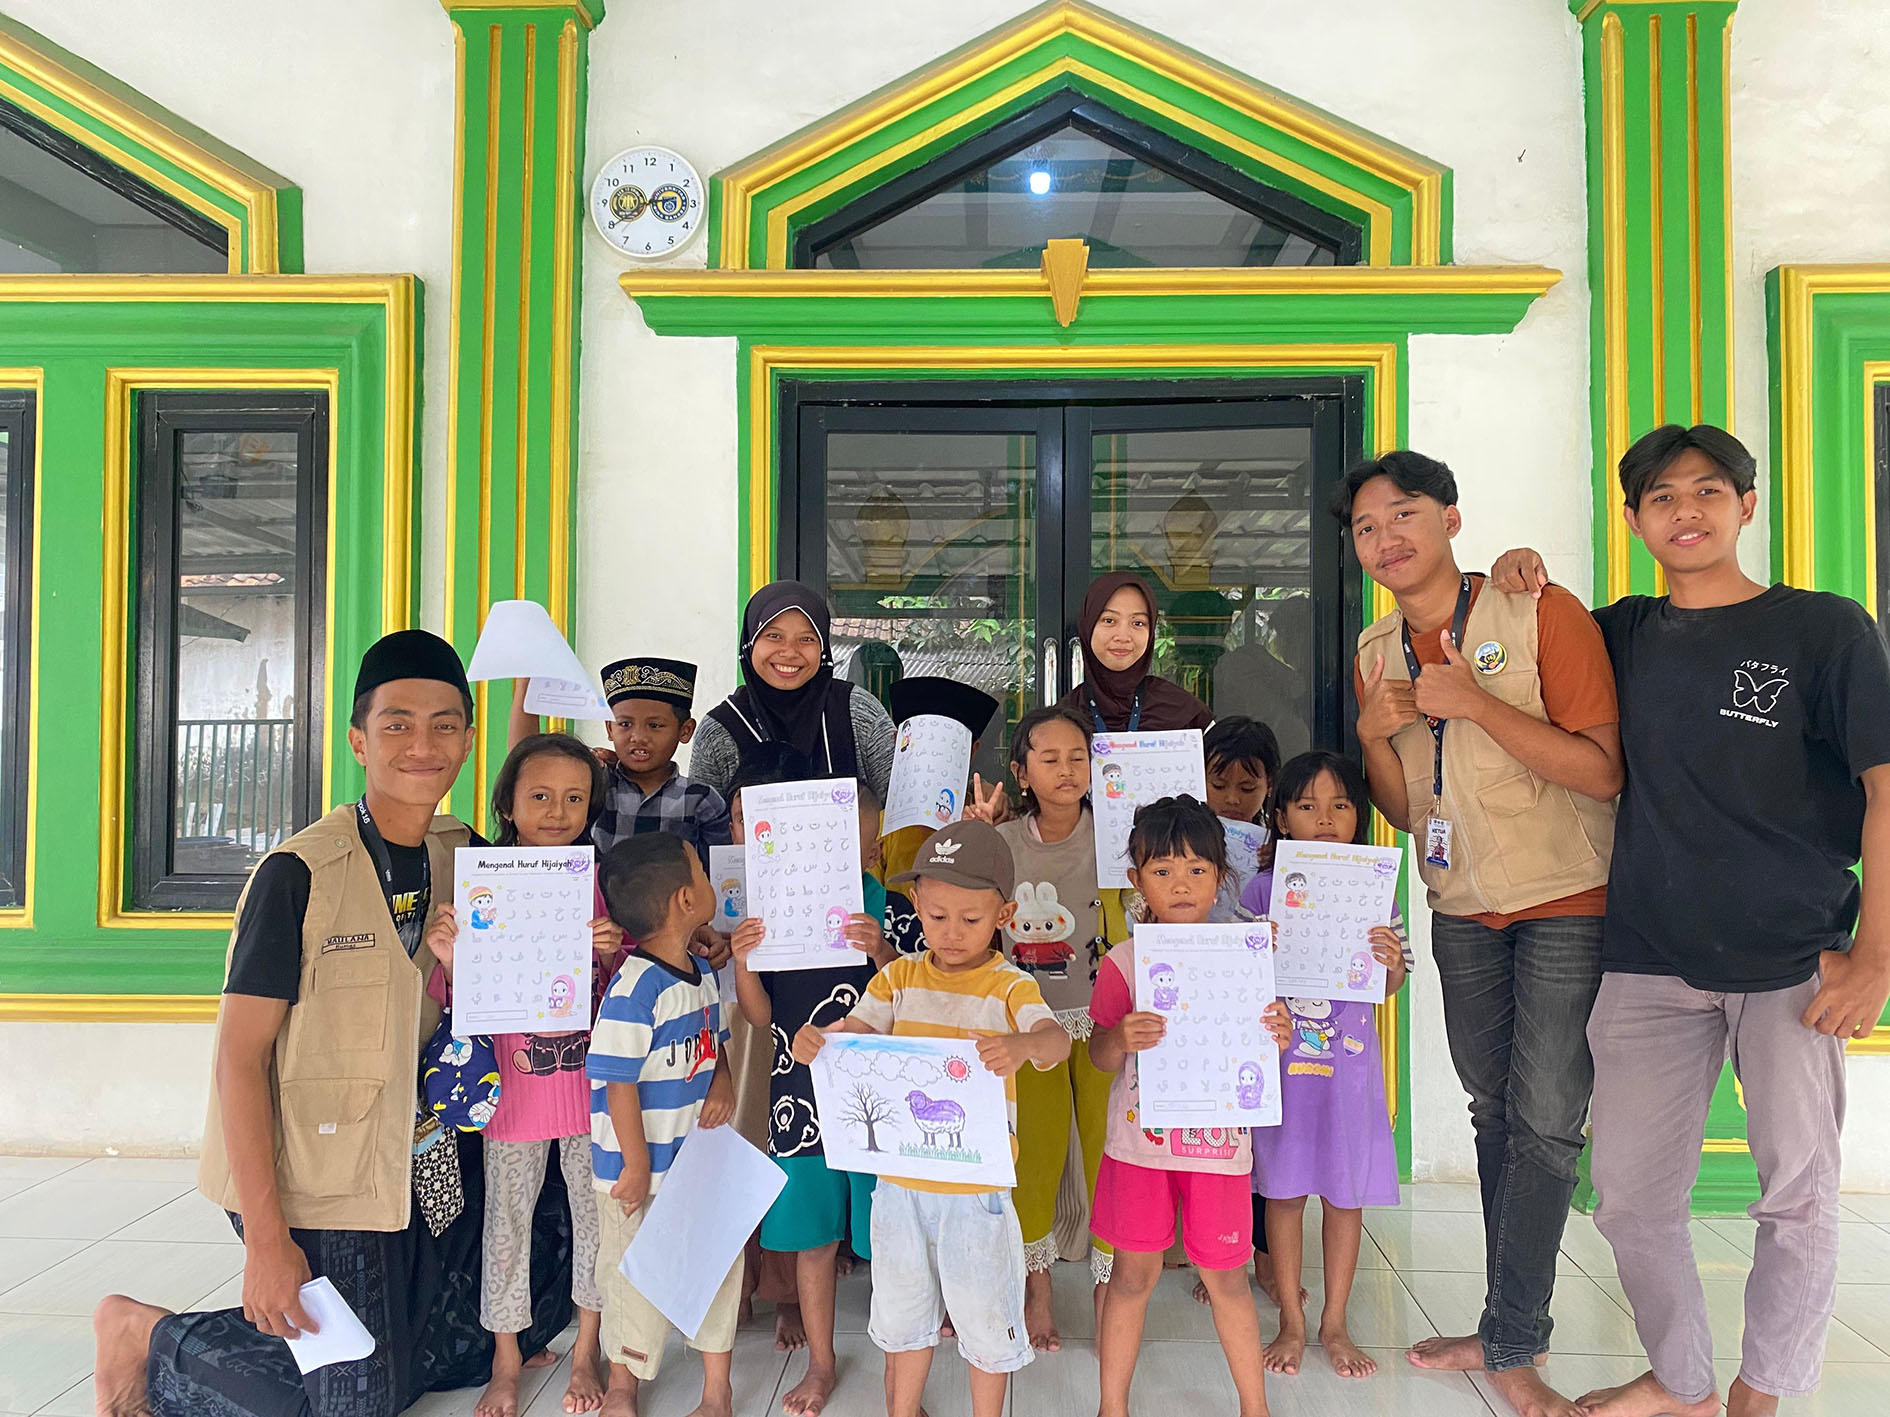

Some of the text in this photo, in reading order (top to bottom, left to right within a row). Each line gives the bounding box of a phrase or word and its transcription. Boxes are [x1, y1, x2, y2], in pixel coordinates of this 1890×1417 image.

[645, 158, 656, 166] 12
[624, 165, 633, 173] 11
[607, 178, 619, 186] 10
[683, 179, 689, 187] 2
[602, 199, 608, 207] 9
[690, 200, 696, 208] 3
[608, 221, 615, 229] 8
[623, 236, 629, 244] 7
[668, 236, 674, 244] 5
[645, 242, 651, 250] 6
[1740, 660, 1788, 676] バタフライ
[1720, 708, 1778, 728] BUTTERFLY
[930, 856, 954, 864] adidas
[478, 860, 514, 872] Mengenal
[518, 860, 538, 869] Huruf
